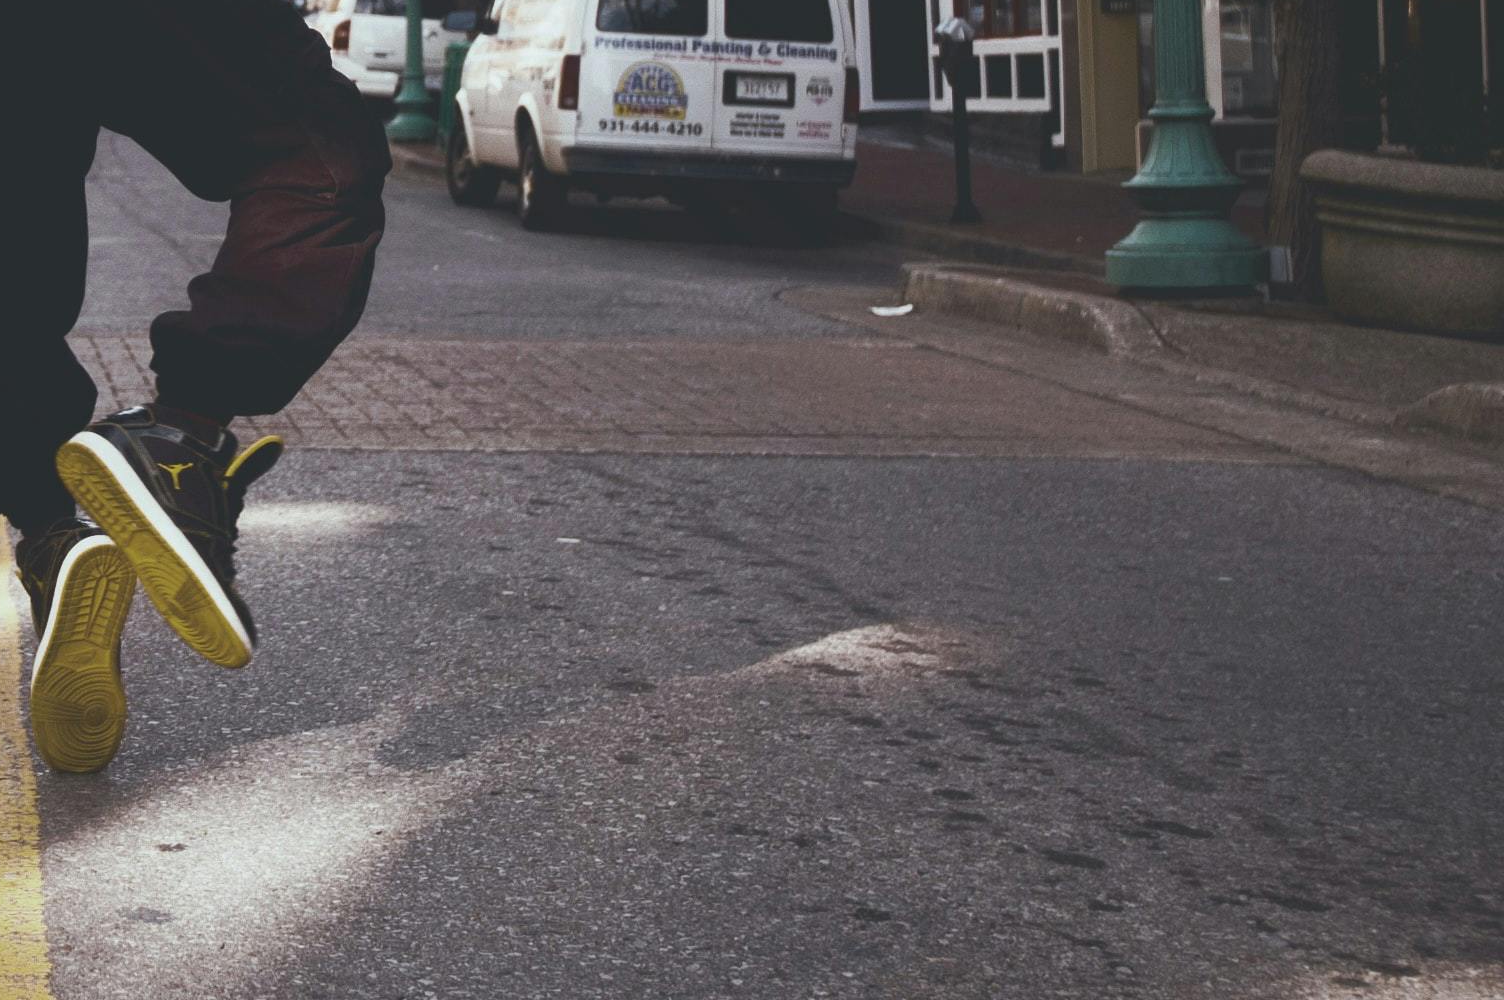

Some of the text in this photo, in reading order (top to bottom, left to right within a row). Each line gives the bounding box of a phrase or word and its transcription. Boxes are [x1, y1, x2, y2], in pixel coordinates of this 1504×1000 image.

[595, 36, 687, 51] Professional
[692, 39, 753, 57] Painting
[758, 41, 771, 56] &
[776, 42, 837, 62] Cleaning
[598, 118, 704, 138] 931-444-4210
